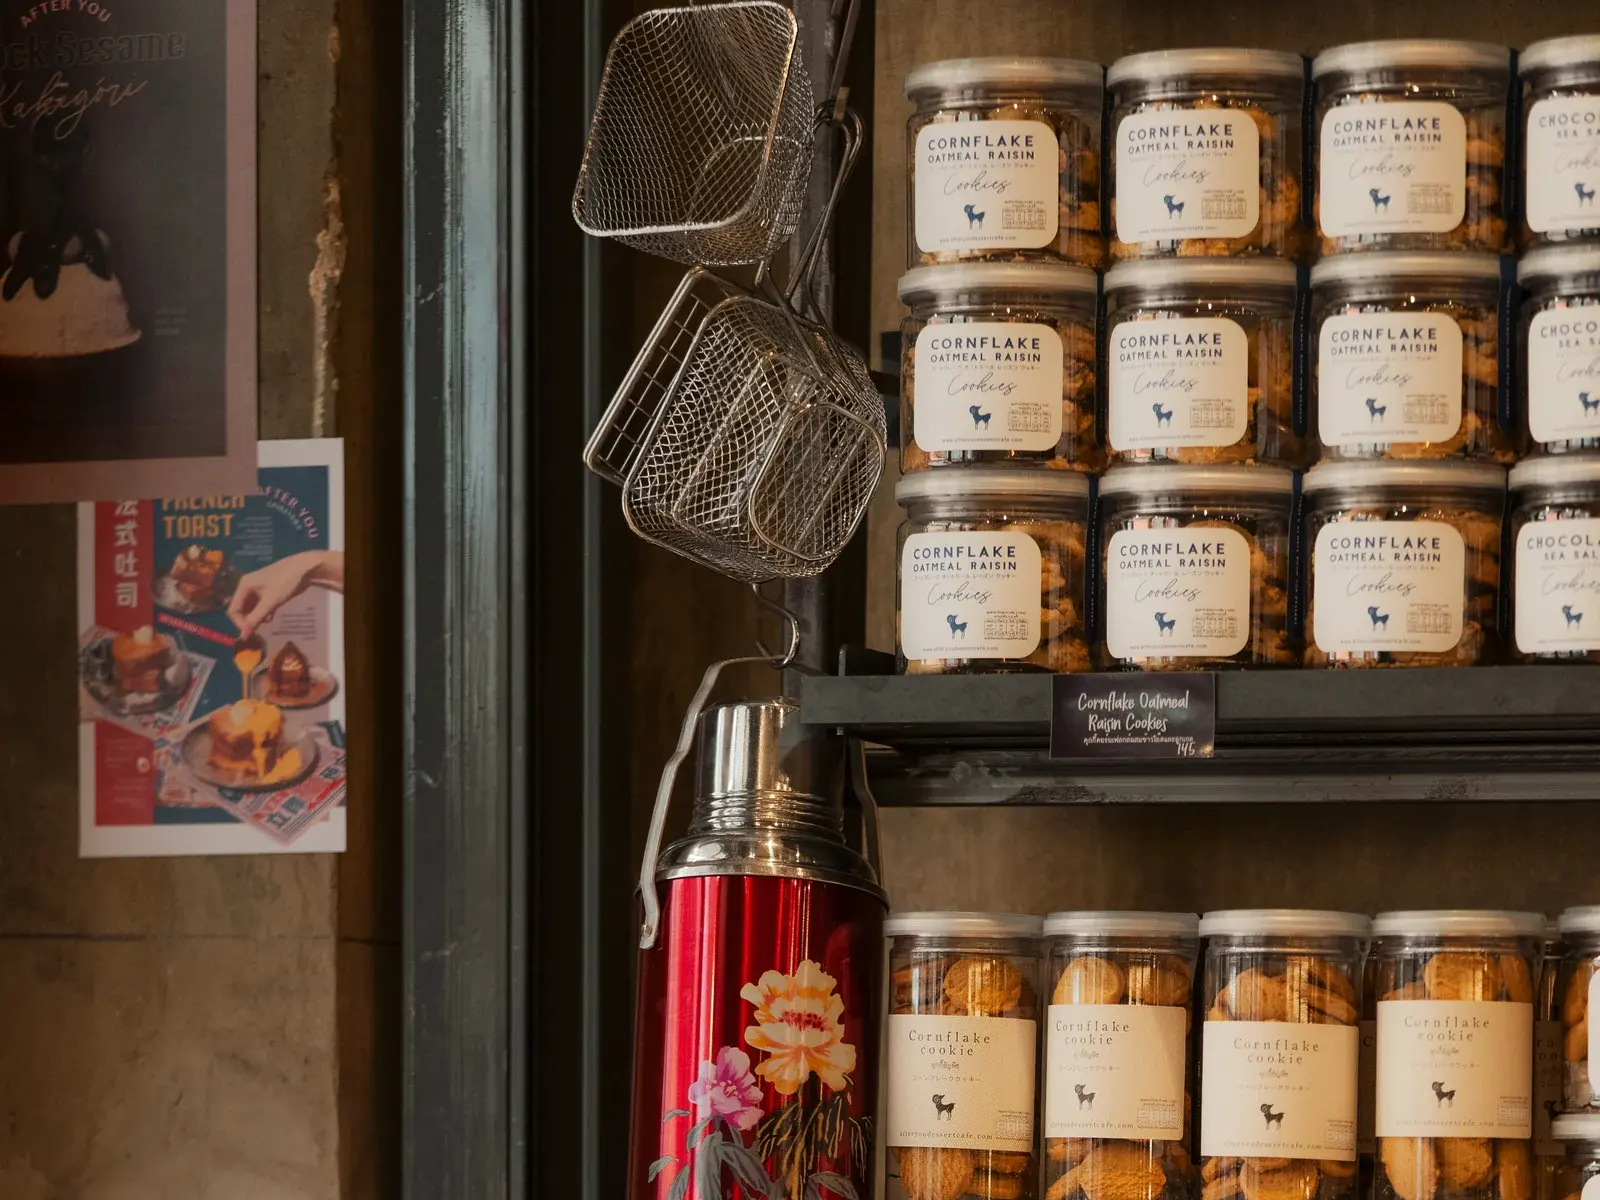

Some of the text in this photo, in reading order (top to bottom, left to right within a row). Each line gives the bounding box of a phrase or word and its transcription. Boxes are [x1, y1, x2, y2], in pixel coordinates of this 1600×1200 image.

[19, 0, 112, 28] AFTER YOU
[54, 30, 187, 70] Sesame
[1334, 117, 1441, 134] CORNFLAKE
[1539, 112, 1600, 128] CHOCO
[1128, 124, 1233, 142] CORNFLAKE
[1333, 133, 1442, 147] OATMEAL RAISIN
[1556, 128, 1578, 139] SEA
[928, 135, 1034, 151] CORNFLAKE
[1128, 140, 1234, 155] OATMEAL RAISIN
[928, 151, 1035, 164] OATMEAL RAISIN
[1143, 160, 1210, 187] Cookies
[1348, 153, 1416, 180] Cookies
[943, 170, 1012, 196] Cookies
[1120, 333, 1222, 349] CORNFLAKE
[1331, 328, 1437, 343] CORNFLAKE
[931, 337, 1040, 350] CORNFLAKE
[1331, 344, 1438, 356] OATMEAL RAISIN
[1558, 338, 1580, 348] SEA
[930, 353, 1041, 363] OATMEAL RAISIN
[1119, 349, 1223, 362] OATMEAL RAISIN
[947, 371, 1018, 396] Cookies
[1133, 369, 1200, 394] Cookies
[1345, 364, 1414, 390] Cookies
[163, 514, 233, 539] TOAST
[298, 507, 320, 539] YOU
[1330, 537, 1441, 550] CORNFLAKE
[1527, 534, 1600, 550] CHOCOL
[913, 546, 1016, 560] CORNFLAKE
[1120, 543, 1225, 557] CORNFLAKE
[1330, 552, 1441, 562] OATMEAL RAISIN
[1544, 552, 1565, 561] SEA
[913, 561, 1017, 572] OATMEAL RAISIN
[1120, 558, 1226, 570] OATMEAL RAISIN
[1134, 578, 1202, 603] Cookies
[1345, 571, 1417, 597] Cookies
[927, 581, 994, 606] Cookies
[1078, 690, 1190, 712] Cornflake Oatmeal
[1088, 712, 1168, 733] Raisin Cookies
[1056, 1020, 1130, 1032] Cornflake
[1404, 1016, 1490, 1028] Cornflake
[908, 1030, 991, 1044] Cornflake
[1064, 1034, 1113, 1045] cookie
[1417, 1030, 1474, 1041] cookie
[920, 1044, 975, 1056] cookie
[1233, 1038, 1320, 1051] Cornflake
[1247, 1053, 1303, 1064] cookie
